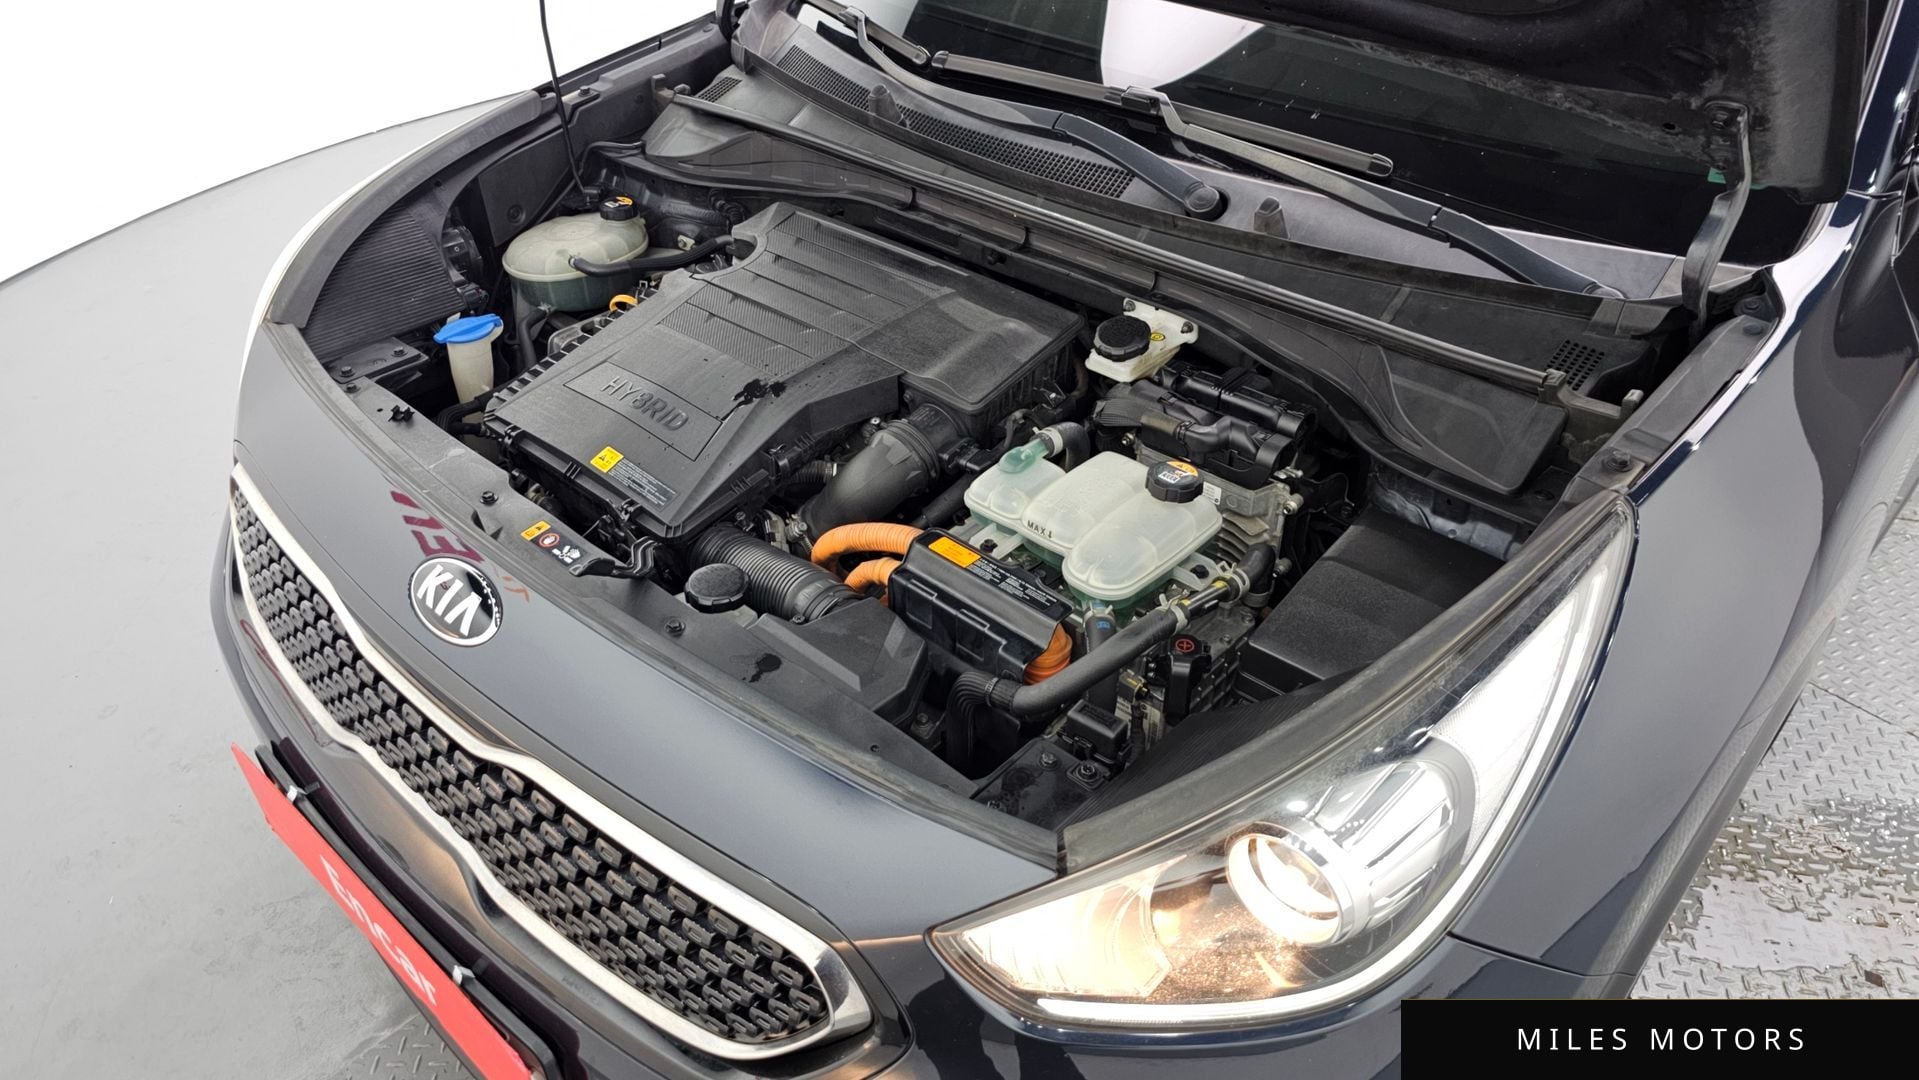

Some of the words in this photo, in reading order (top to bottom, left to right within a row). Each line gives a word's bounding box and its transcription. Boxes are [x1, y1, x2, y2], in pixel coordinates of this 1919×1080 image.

[600, 376, 689, 431] HYBRID
[1027, 520, 1046, 536] MAX
[417, 564, 482, 637] KIA
[320, 854, 437, 1006] Encar
